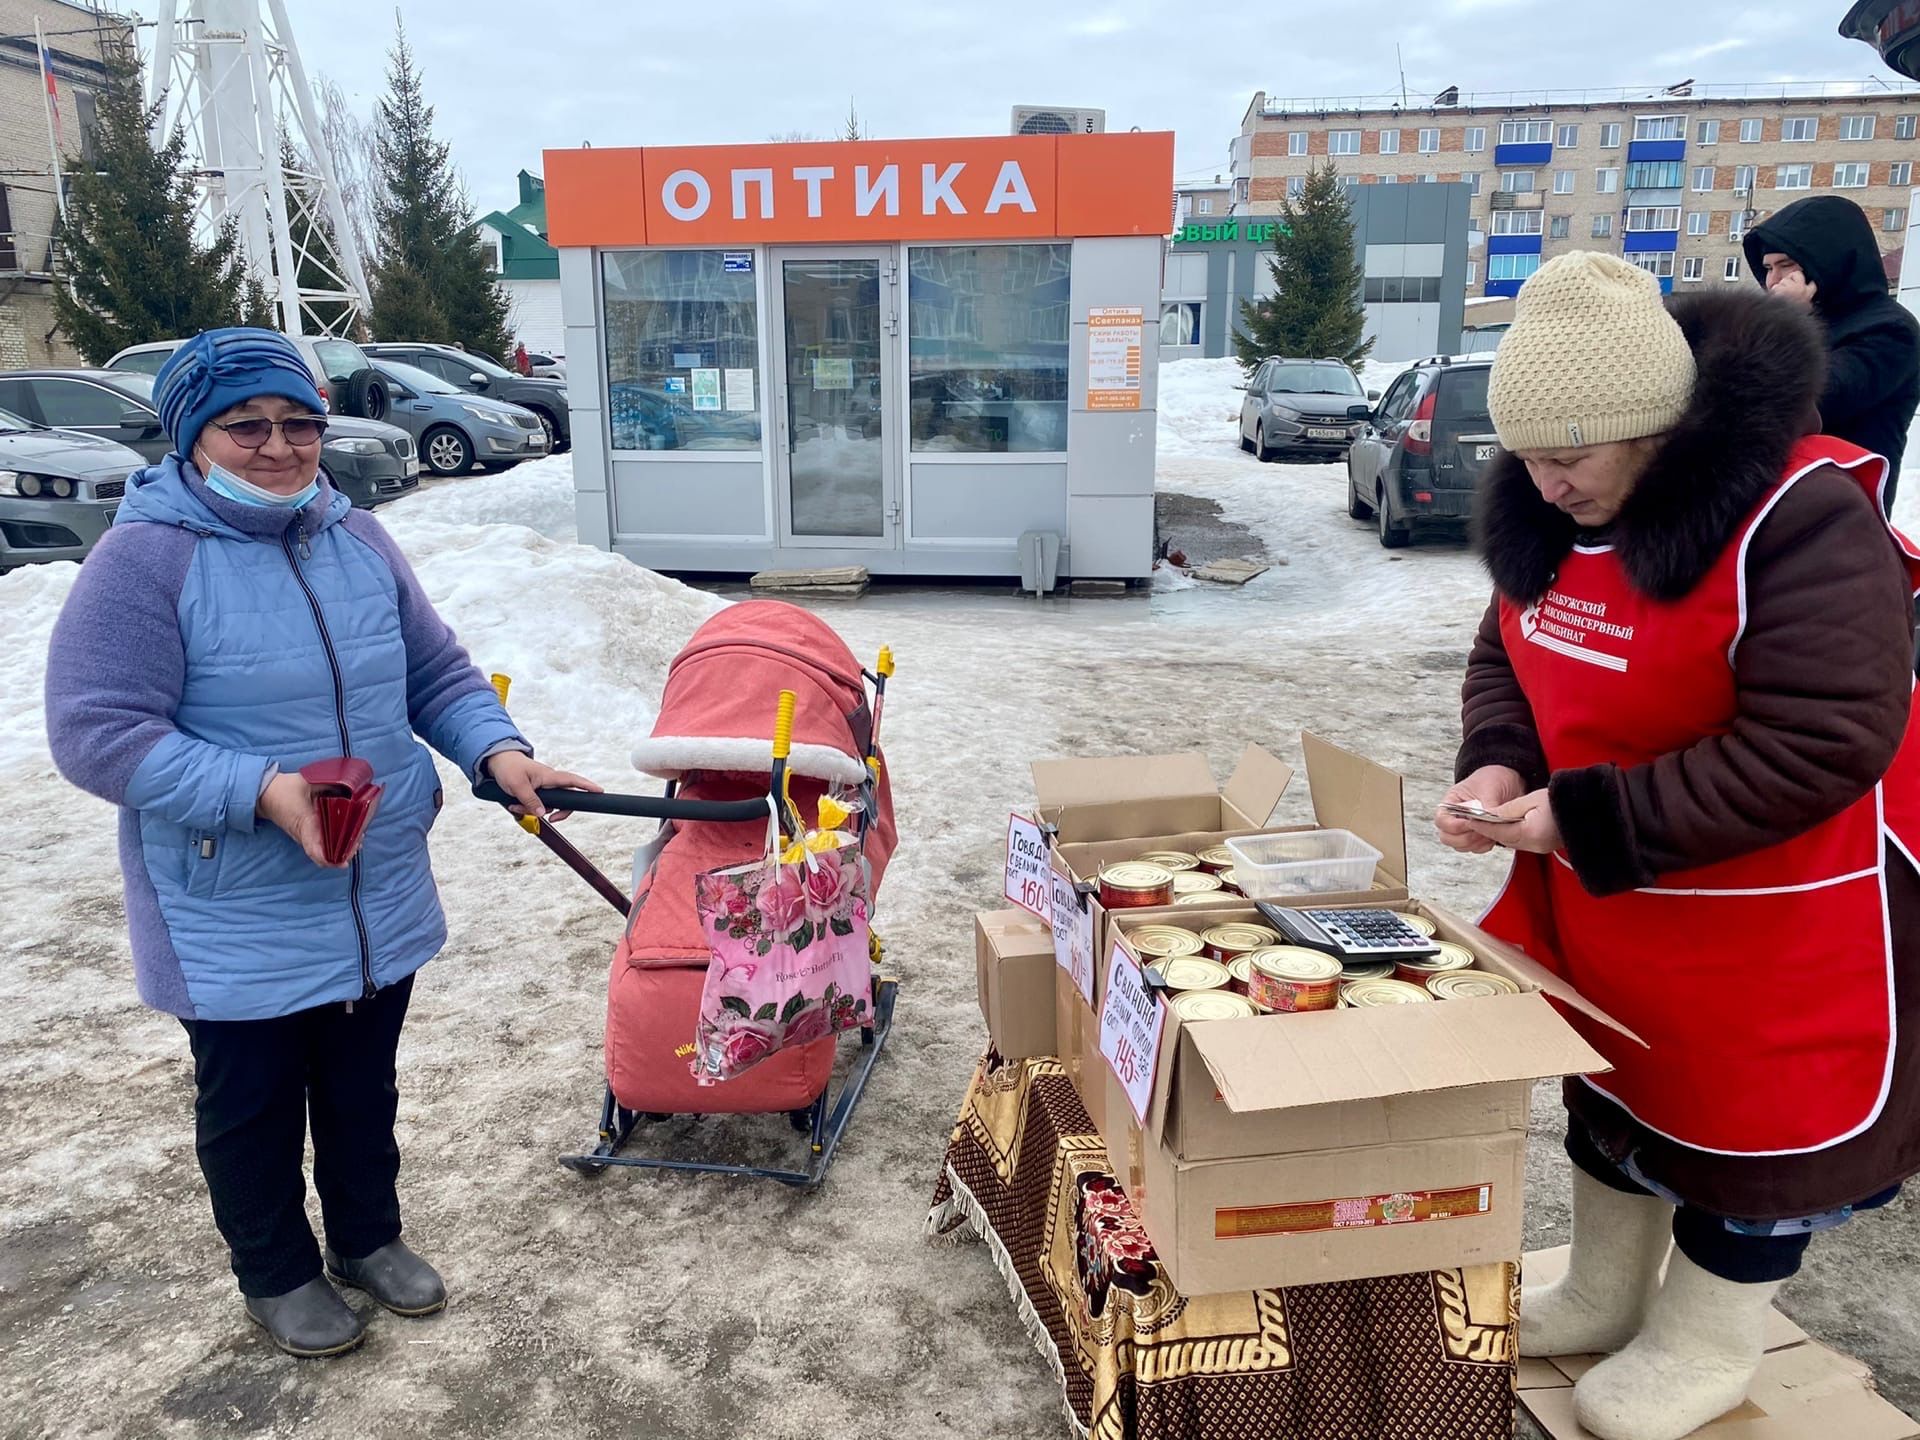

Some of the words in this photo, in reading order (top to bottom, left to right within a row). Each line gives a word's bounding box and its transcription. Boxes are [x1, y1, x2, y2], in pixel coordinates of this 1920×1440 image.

[661, 160, 1037, 222] ОПТИКА
[1546, 590, 1607, 617] ЕЛАБУЖСКИЙ
[1540, 619, 1586, 643] КОМБИНАТ
[1543, 604, 1634, 640] МЯСОКОНСЕРВНЫЙ
